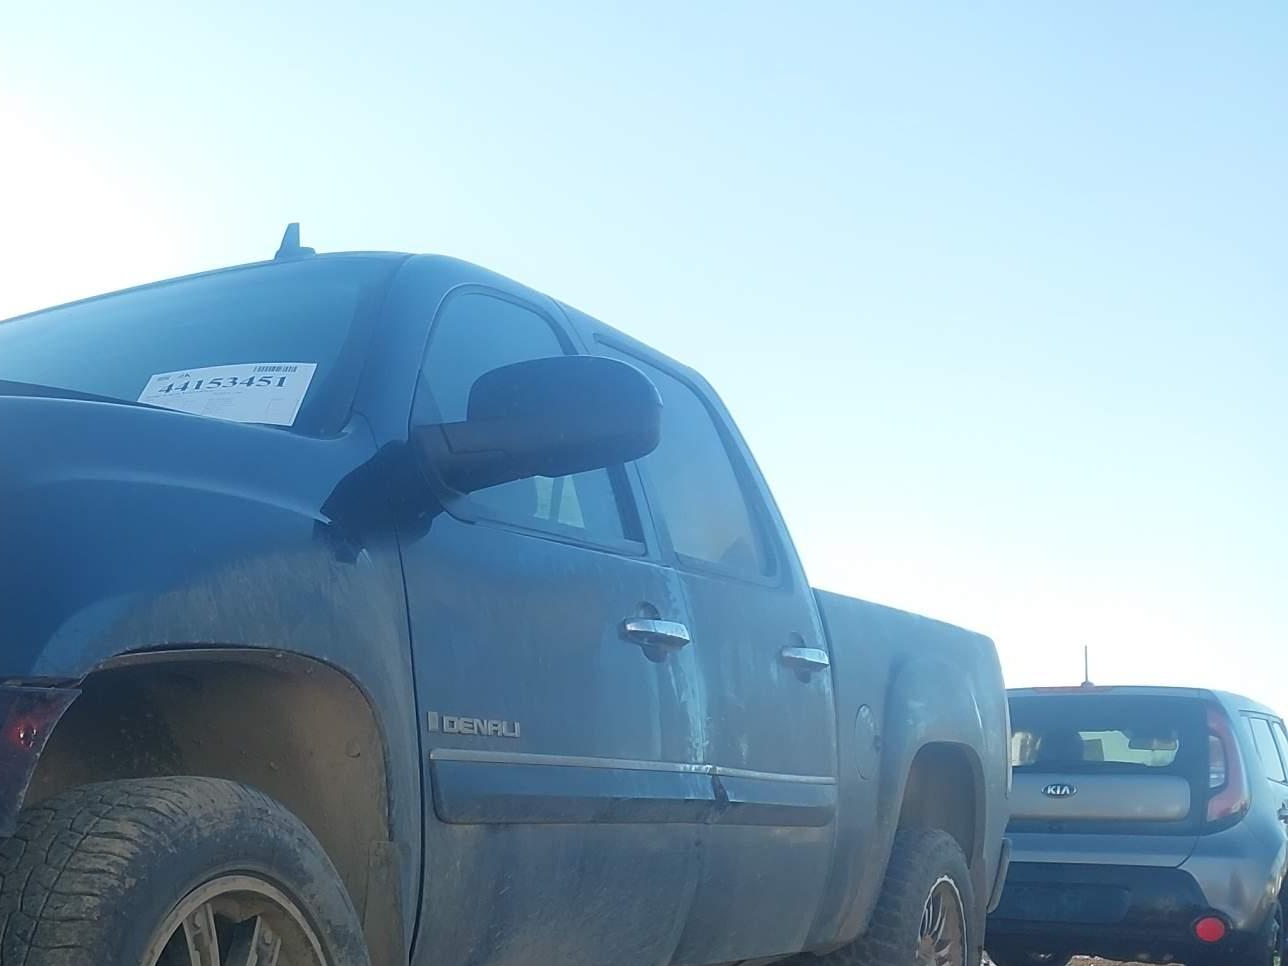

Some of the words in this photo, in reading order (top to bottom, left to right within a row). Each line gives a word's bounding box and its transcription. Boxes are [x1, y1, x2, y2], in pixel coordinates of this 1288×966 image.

[158, 375, 288, 395] 44153451
[442, 714, 521, 738] DENALI
[1046, 784, 1071, 796] KIA
